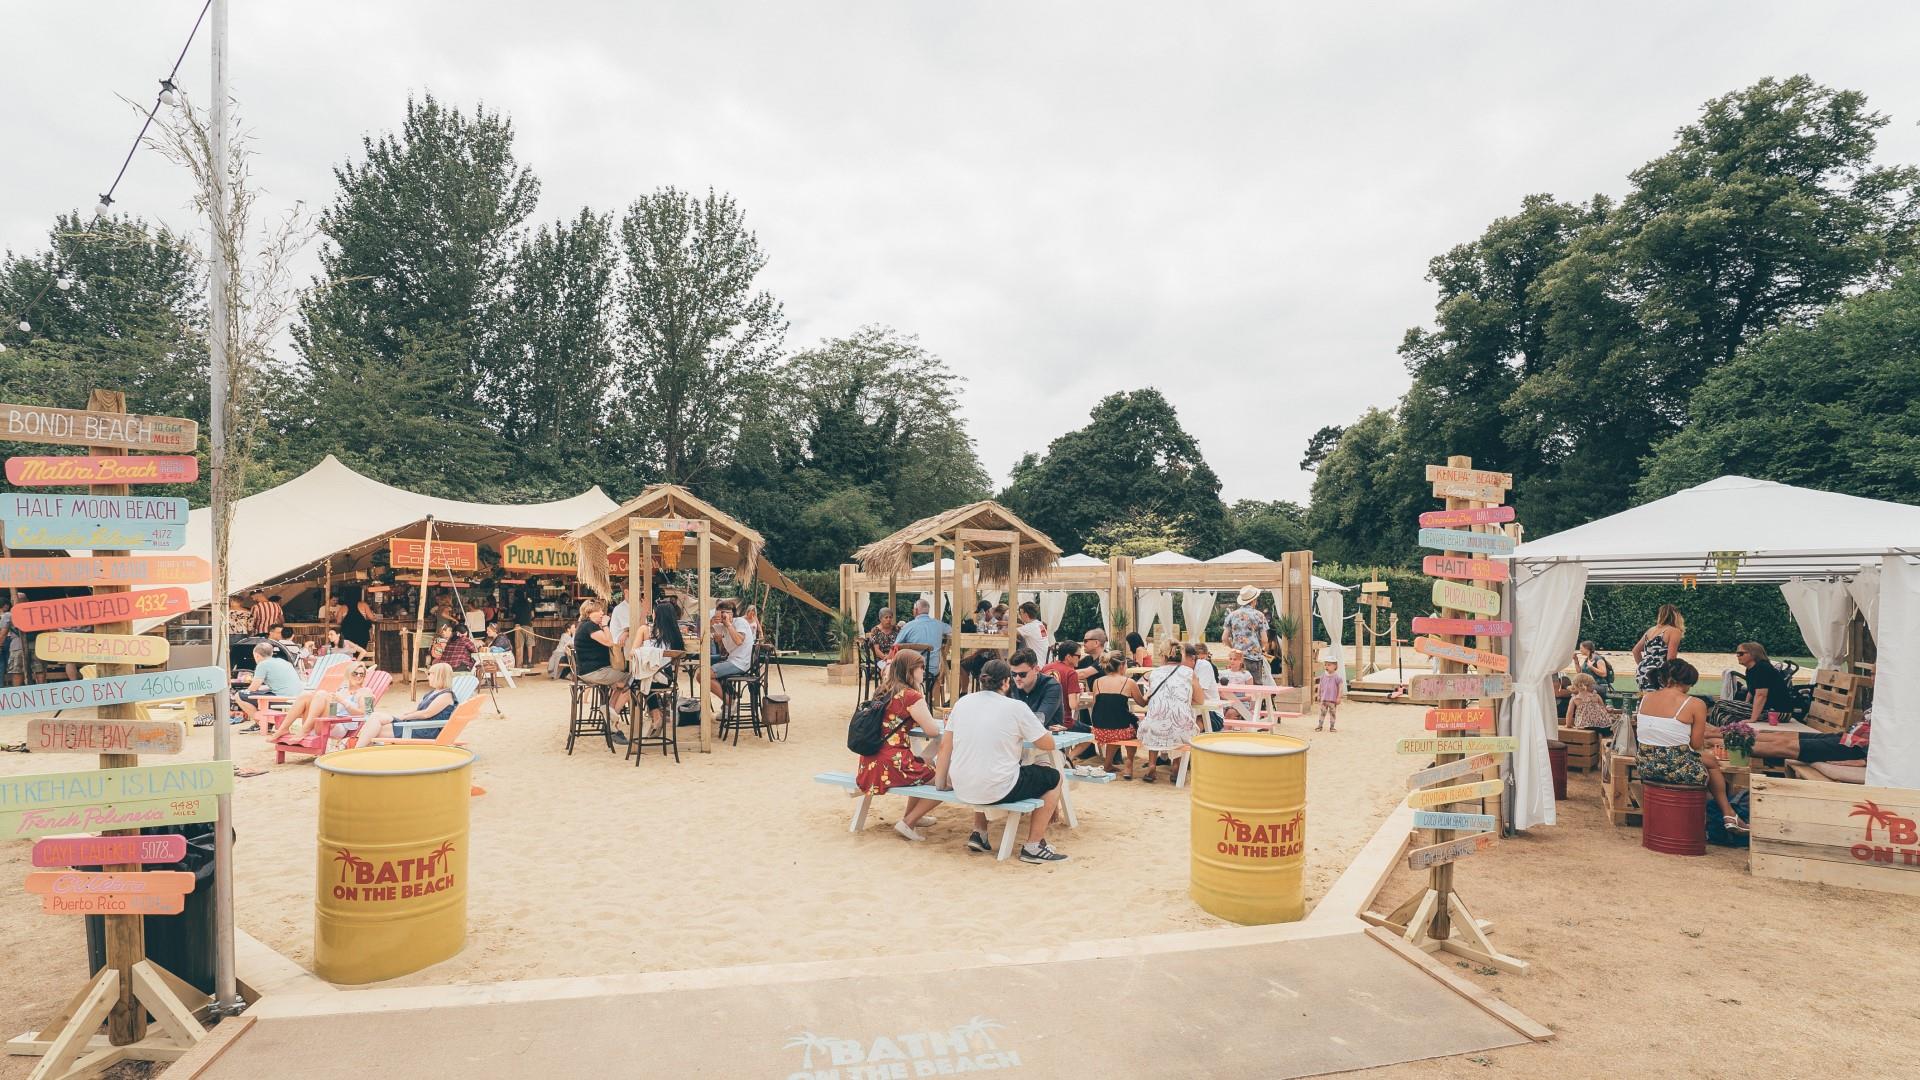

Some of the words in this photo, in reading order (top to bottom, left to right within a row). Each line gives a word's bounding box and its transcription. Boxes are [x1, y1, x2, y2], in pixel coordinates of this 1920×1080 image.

[8, 409, 73, 438] BONDI
[85, 416, 151, 442] BEACH
[153, 434, 180, 445] MILES
[95, 459, 158, 480] Beach
[16, 498, 63, 519] HALF
[72, 498, 121, 519] MOON
[126, 499, 176, 520] BEACH
[409, 544, 460, 555] Bach
[506, 545, 544, 565] PURA
[545, 548, 577, 566] VIDA
[1435, 560, 1467, 576] HAITI
[23, 597, 130, 625] TRINIDAD
[48, 634, 151, 657] BARBADOS
[0, 685, 85, 710] MONTEGO
[93, 680, 127, 701] BAY
[188, 676, 212, 691] miles
[1435, 711, 1462, 722] TRUNK
[1468, 711, 1485, 722] BAY
[41, 723, 97, 748] SHOAL
[103, 725, 135, 749] BAY
[1438, 740, 1463, 751] BEACH
[120, 768, 214, 796] ISLAND
[170, 800, 200, 810] 9489
[16, 807, 80, 834] French
[1236, 823, 1294, 843] BATH
[141, 841, 169, 859] 5078
[1217, 842, 1238, 856] ON
[1242, 845, 1268, 858] THE
[1851, 844, 1894, 865] ON
[356, 855, 436, 884] BATH
[333, 885, 358, 901] ON
[362, 886, 396, 902] THE
[401, 874, 454, 899] BEACH
[53, 896, 93, 911] Puerto
[97, 896, 126, 910] Rico
[831, 1031, 968, 1066] BATH
[847, 1062, 909, 1080] THE
[913, 1050, 1022, 1077] BEACH
